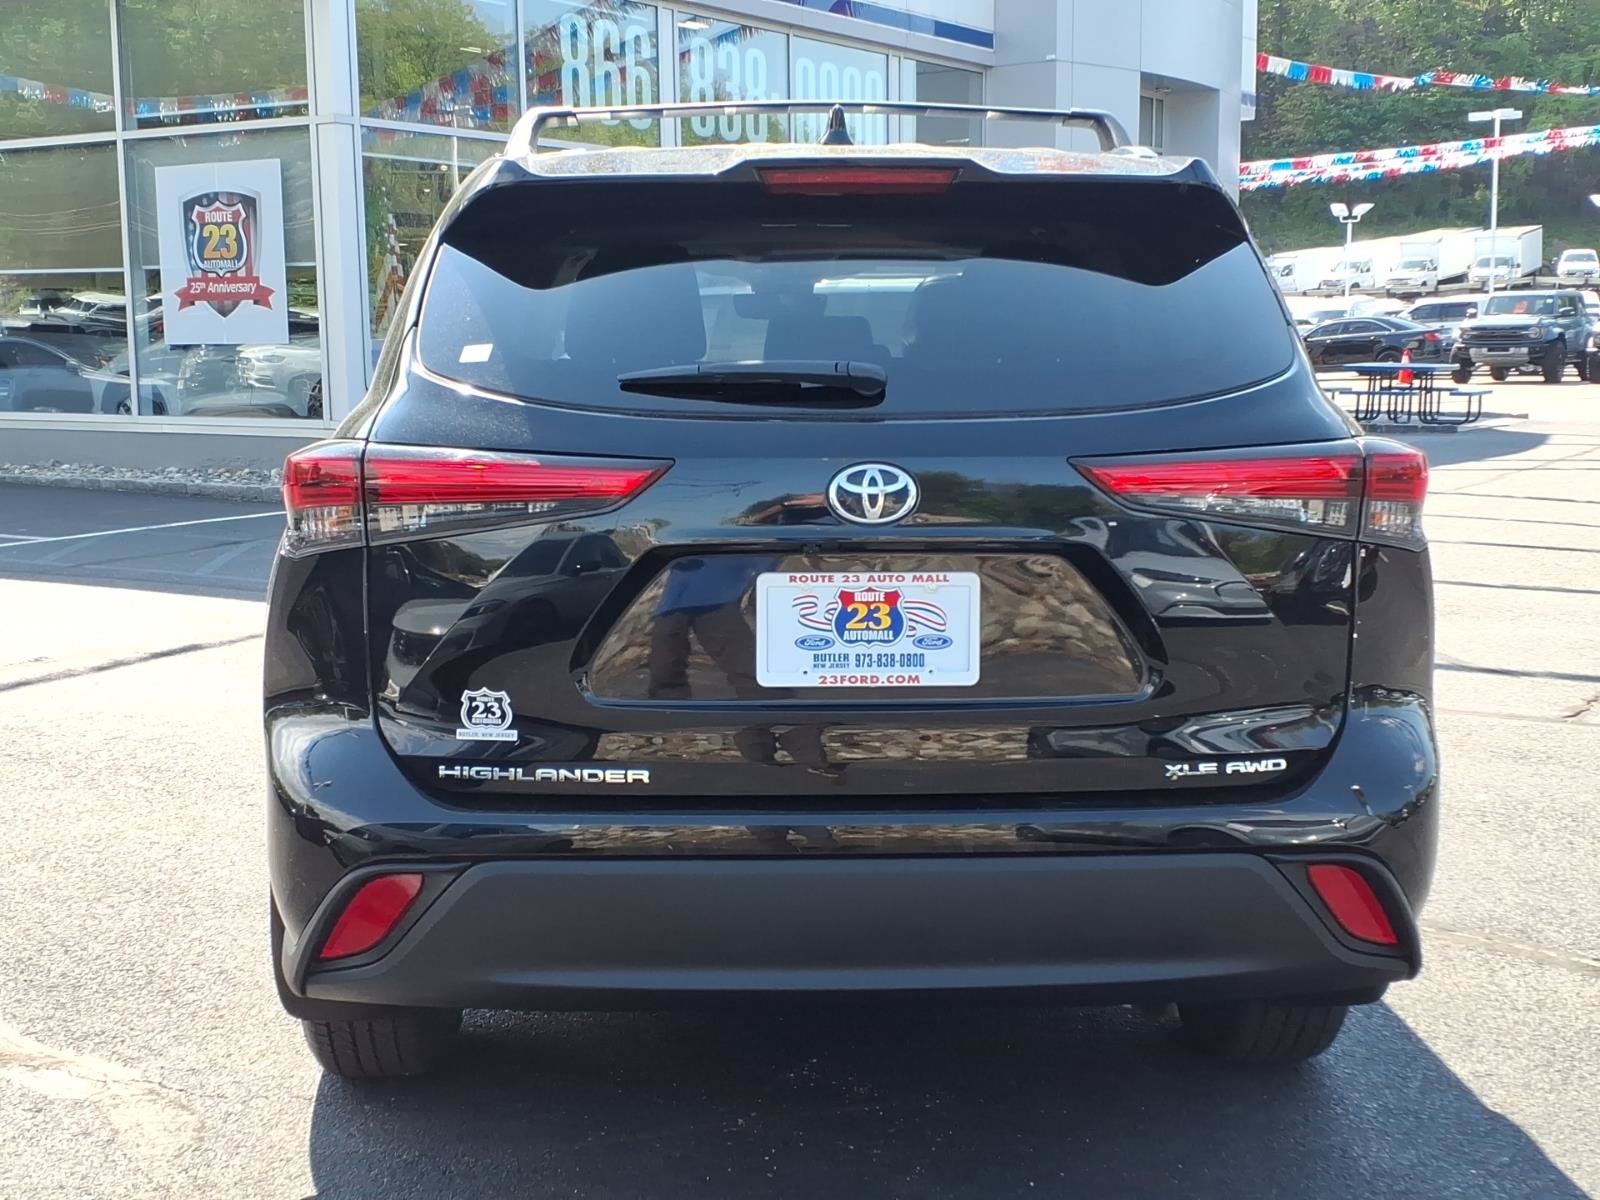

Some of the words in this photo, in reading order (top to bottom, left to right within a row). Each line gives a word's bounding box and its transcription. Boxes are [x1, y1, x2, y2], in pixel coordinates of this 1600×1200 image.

[204, 211, 233, 223] ROUTE
[203, 224, 237, 260] 23
[203, 259, 238, 270] AUTOMALL
[190, 282, 206, 294] 25th
[207, 281, 257, 295] Anniversary
[789, 574, 835, 584] ROUTE
[841, 574, 861, 583] 23
[867, 574, 906, 583] AUTO
[911, 574, 950, 583] MALL
[854, 591, 886, 602] ROUTE
[846, 602, 892, 630] 23
[843, 630, 895, 641] AUTOMALL
[813, 653, 850, 662] BUTLER
[854, 653, 925, 668] 973-838-0800
[818, 674, 921, 685] 23FORD.COM
[471, 701, 502, 719] 23
[1165, 762, 1218, 777] XLE
[1225, 758, 1288, 774] AWD
[438, 765, 650, 784] HIGHLANDER
